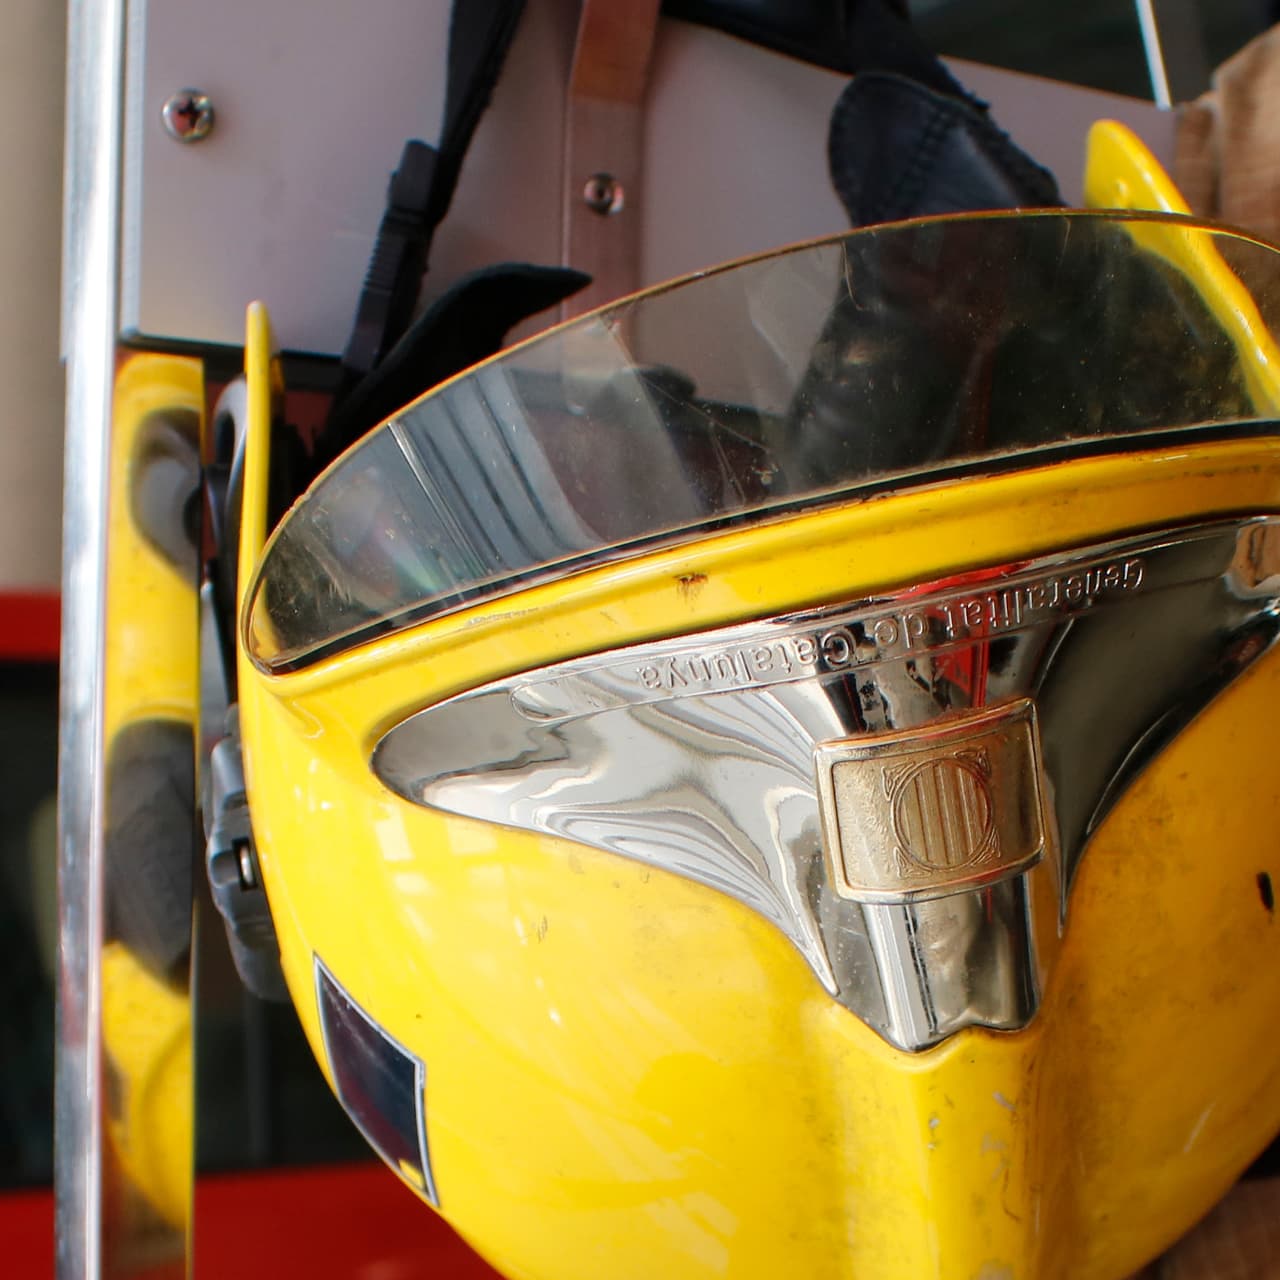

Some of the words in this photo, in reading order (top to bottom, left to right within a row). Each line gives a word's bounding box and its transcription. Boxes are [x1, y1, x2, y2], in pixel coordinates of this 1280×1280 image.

[872, 607, 929, 650] de
[941, 557, 1145, 639] Generalitat
[636, 622, 857, 690] Catalunya
